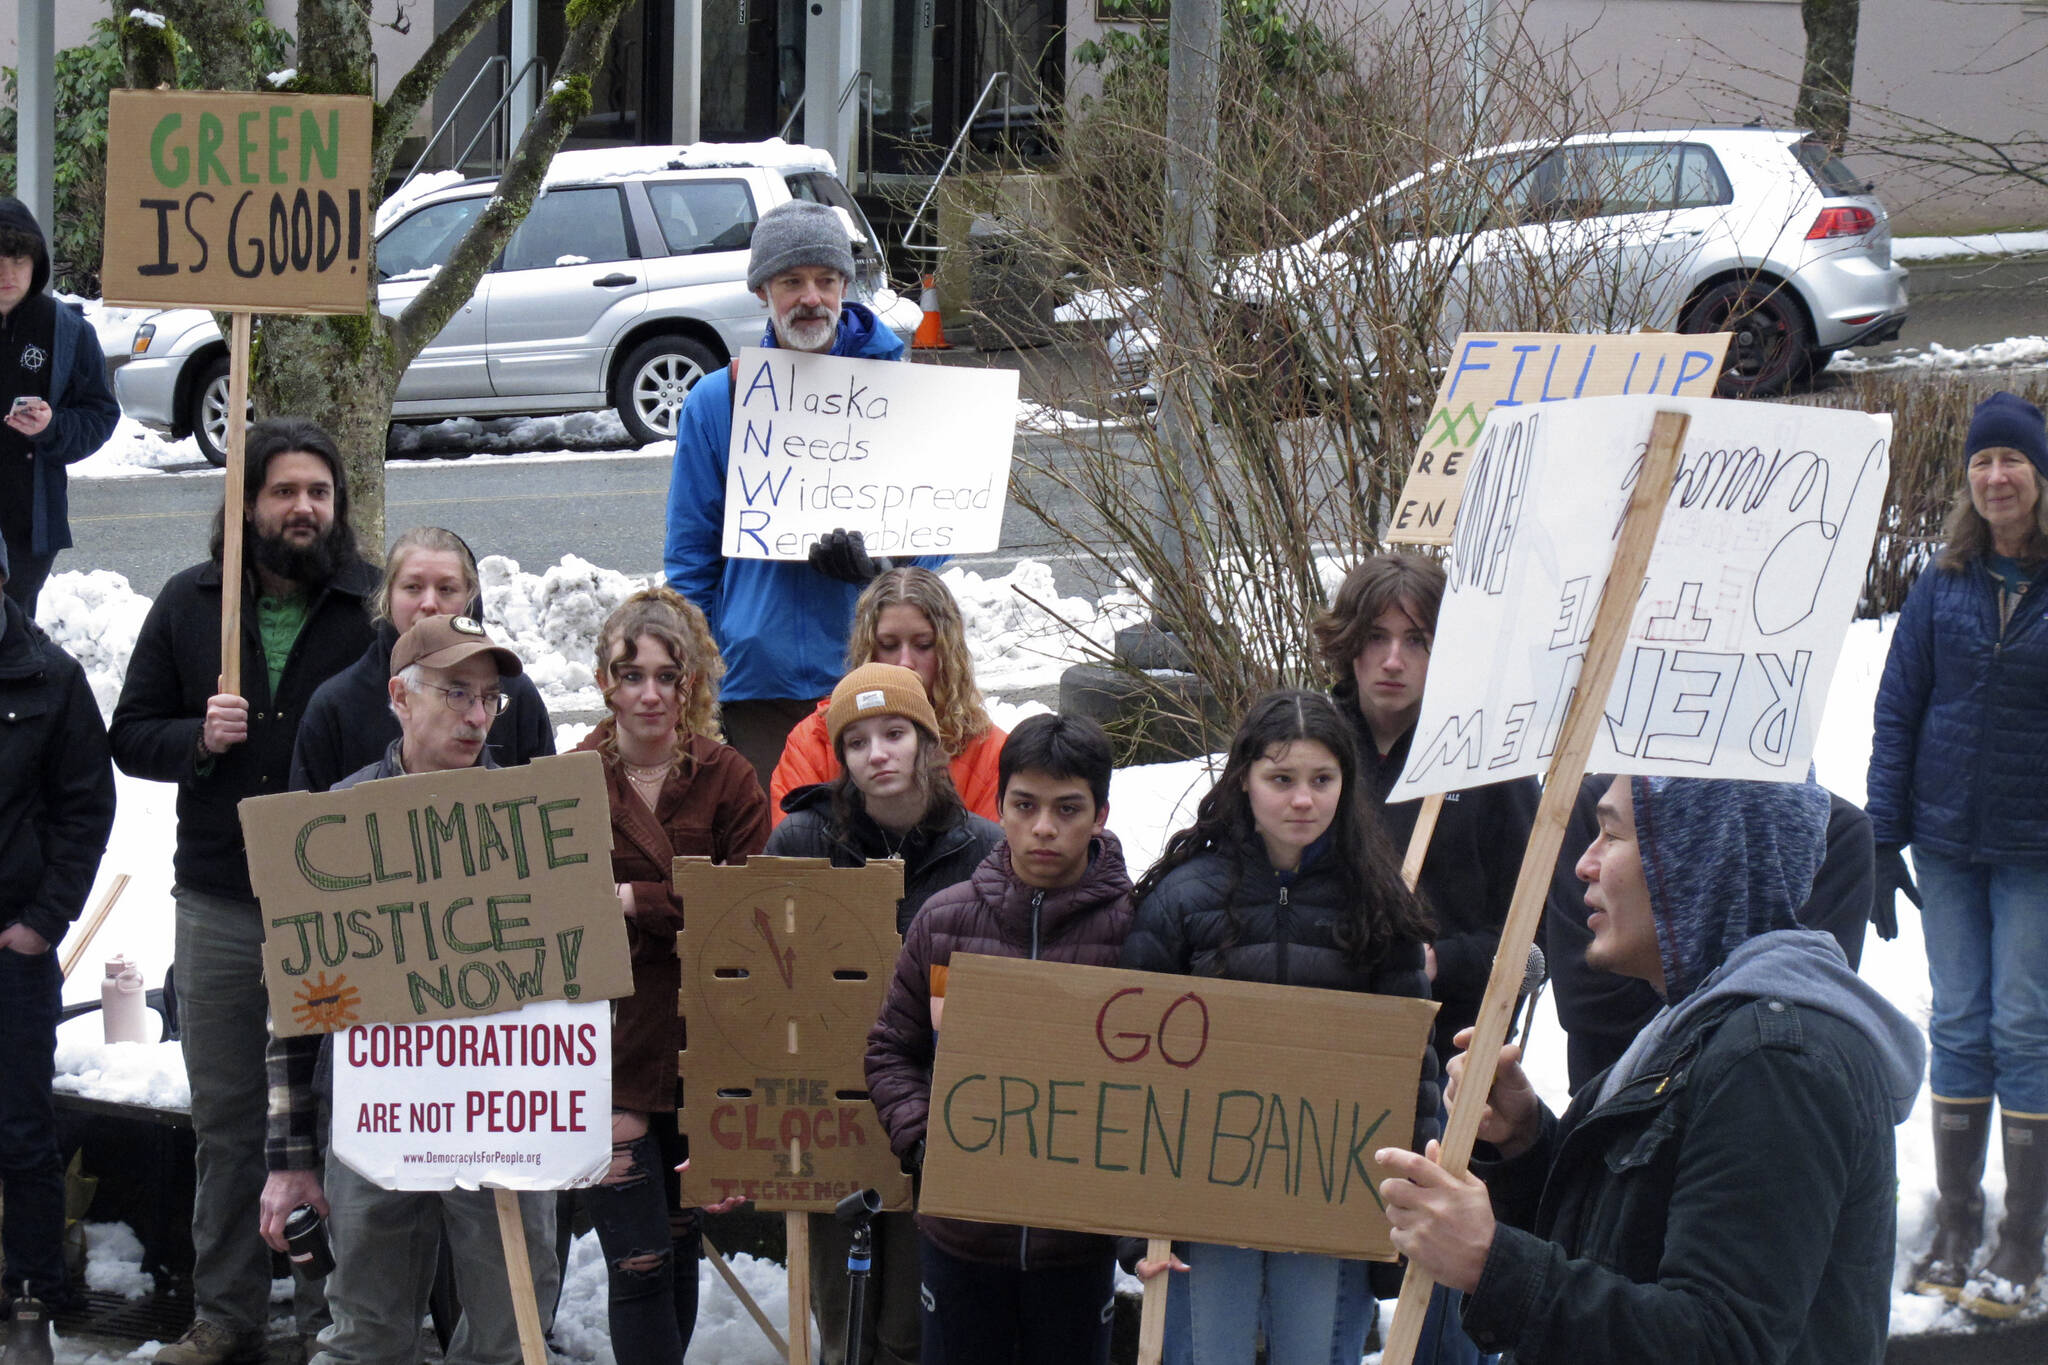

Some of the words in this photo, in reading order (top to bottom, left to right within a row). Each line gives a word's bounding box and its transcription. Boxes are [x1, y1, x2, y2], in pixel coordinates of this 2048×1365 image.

[150, 106, 339, 188] GREEN
[137, 192, 215, 276] IS
[227, 188, 361, 278] GOOD!
[742, 360, 888, 419] Alaska
[1623, 351, 1714, 396] UP
[744, 419, 870, 461] Needs
[738, 466, 994, 521] Widespread
[737, 510, 954, 556] Renables
[1548, 575, 1712, 650] TE
[295, 796, 588, 891] CLIMATE
[272, 894, 545, 976] JUSTICE
[407, 926, 584, 1015] NOW!
[349, 1023, 597, 1067] CORPORATIONS
[1096, 987, 1210, 1069] GO
[357, 1103, 402, 1132] ARE
[410, 1103, 455, 1132] NOT
[466, 1090, 586, 1132] PEOPLE
[755, 1078, 829, 1106] THE
[710, 1104, 866, 1150] CLOCK
[943, 1074, 1190, 1179] GREEN
[1208, 1090, 1391, 1211] BANK
[403, 1151, 542, 1166] www.DemocracyIsForPeople.org
[772, 1152, 815, 1178] IS
